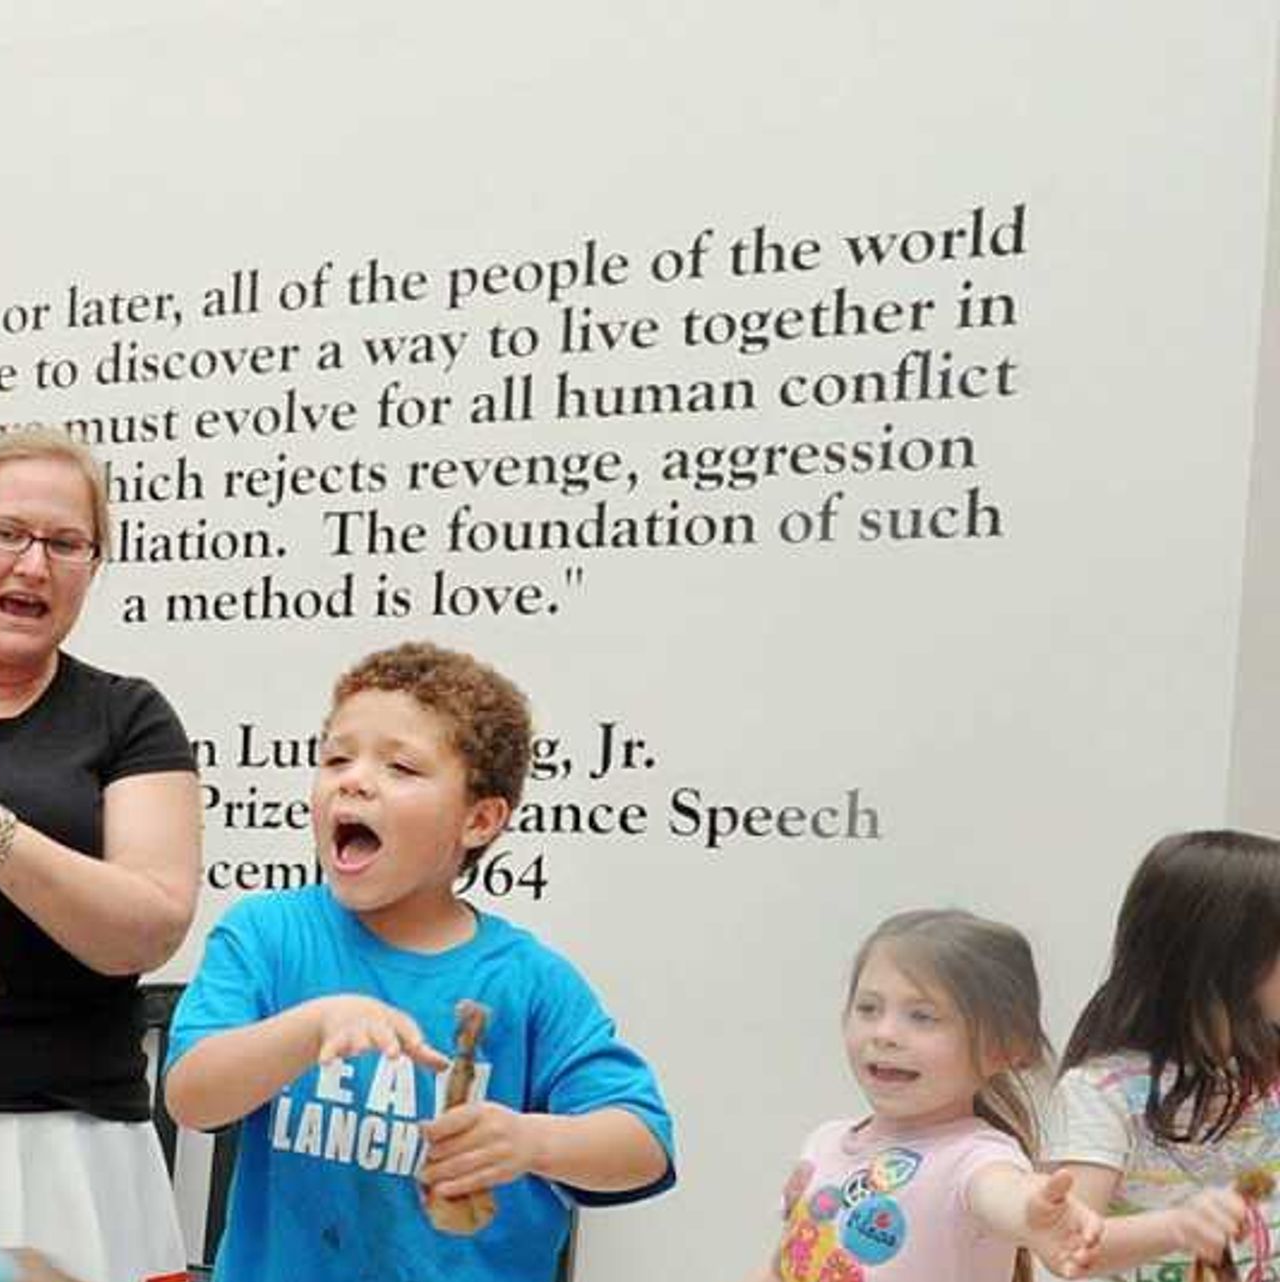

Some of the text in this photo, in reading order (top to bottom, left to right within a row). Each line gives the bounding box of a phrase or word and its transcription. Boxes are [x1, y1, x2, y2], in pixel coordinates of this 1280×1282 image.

[2, 303, 51, 334] or
[67, 285, 182, 329] later,
[201, 269, 262, 318] all
[278, 261, 332, 311] of
[346, 255, 428, 307] the
[445, 239, 630, 311] people
[650, 228, 714, 283] of
[729, 224, 821, 277] the
[842, 202, 1026, 267] world
[33, 356, 79, 390] to
[94, 340, 301, 385] discover
[316, 340, 344, 371] a
[362, 330, 469, 374] way
[487, 320, 540, 359] to
[559, 304, 660, 355] live
[680, 287, 936, 355] together
[955, 279, 1017, 329] in
[63, 406, 180, 447] must
[195, 388, 358, 439] evolve
[377, 380, 453, 429] for
[470, 373, 536, 424] all
[555, 370, 758, 421] human
[778, 350, 1018, 407] conflict
[103, 456, 205, 504] hich
[224, 451, 387, 509] rejects
[406, 451, 638, 499] revenge,
[661, 424, 977, 492] aggression
[323, 509, 427, 557] The
[446, 501, 758, 554] foundation
[778, 492, 845, 544] of
[857, 487, 1004, 543] such
[122, 566, 583, 624] a method is love."
[237, 723, 321, 768] Lut
[589, 721, 655, 780] Jr.
[668, 787, 881, 849] Speech
[271, 1096, 424, 1176] LANCH
